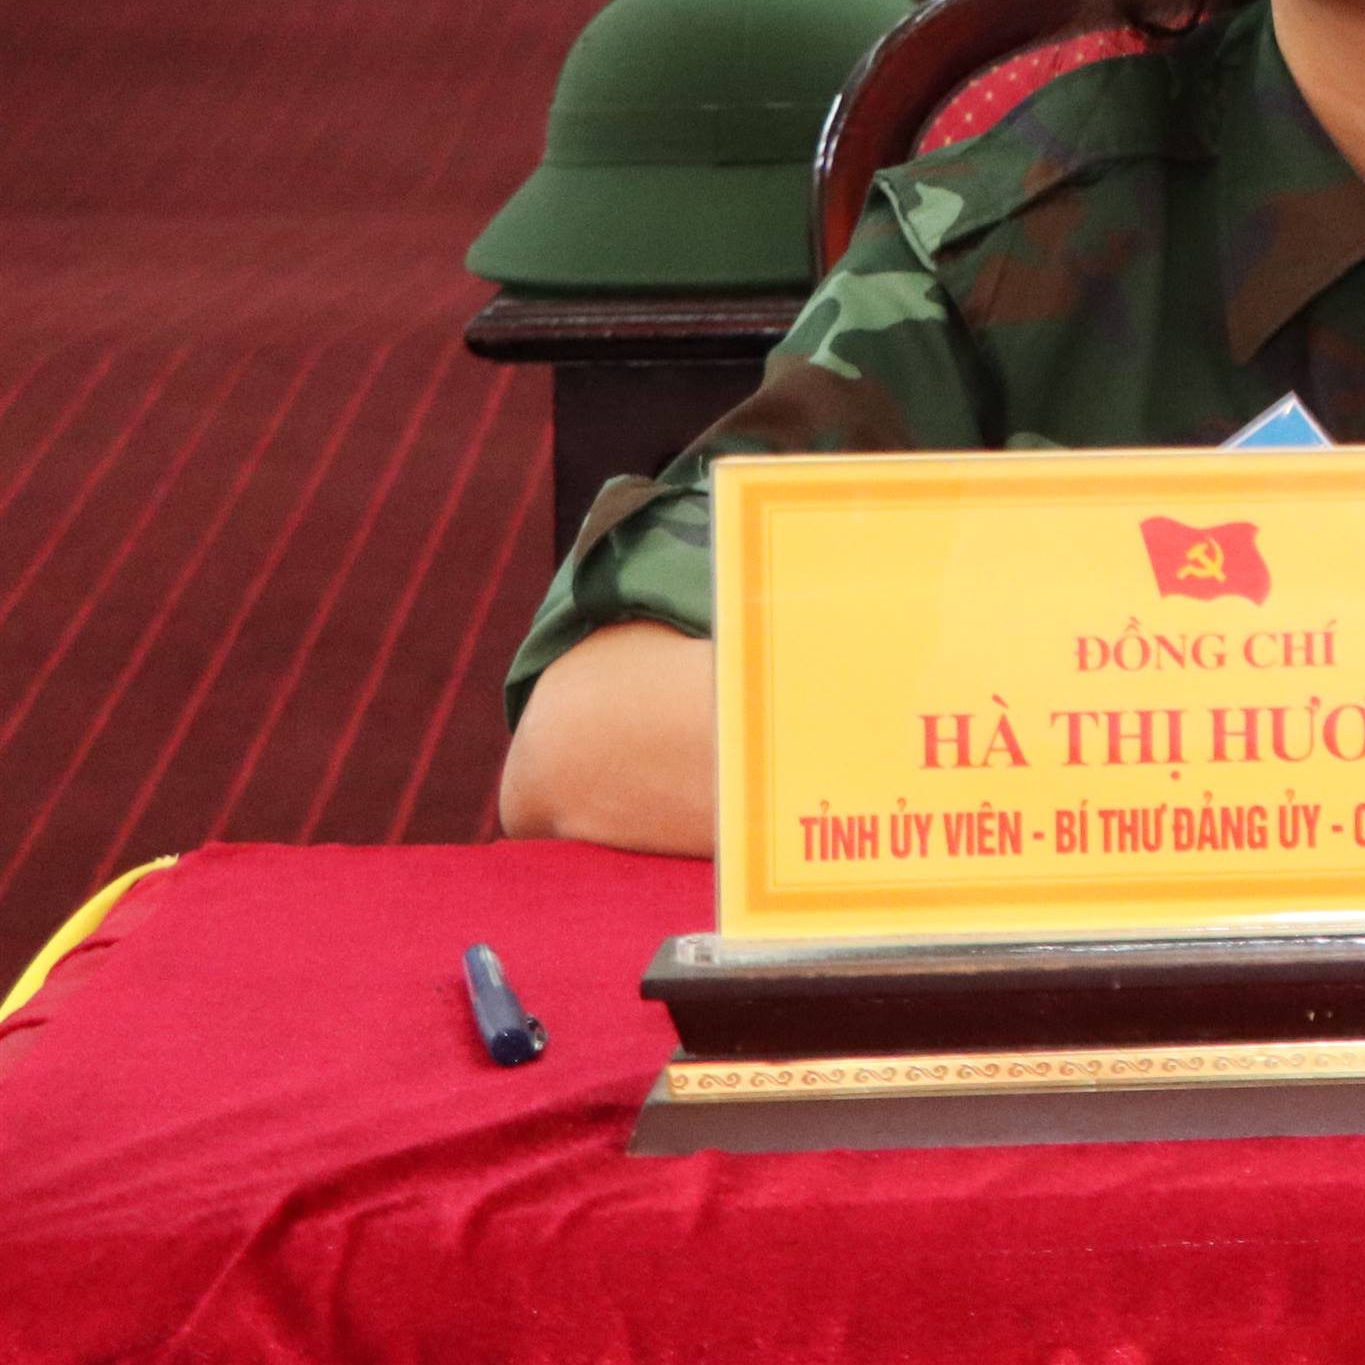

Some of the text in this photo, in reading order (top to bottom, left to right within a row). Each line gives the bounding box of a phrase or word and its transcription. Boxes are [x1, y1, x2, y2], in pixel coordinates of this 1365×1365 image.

[1073, 615, 1337, 673] ĐỒNG CHÍ
[918, 692, 1031, 771] HÀ
[1049, 708, 1186, 781] THỊ
[798, 798, 881, 864] TỈNH
[889, 796, 935, 861] ỦY
[942, 799, 1024, 858] VIÊN
[1054, 798, 1090, 856] BÍ
[1096, 801, 1169, 855] THƯ
[1171, 789, 1269, 853] ĐẢNG
[1277, 787, 1322, 851] ỦY
